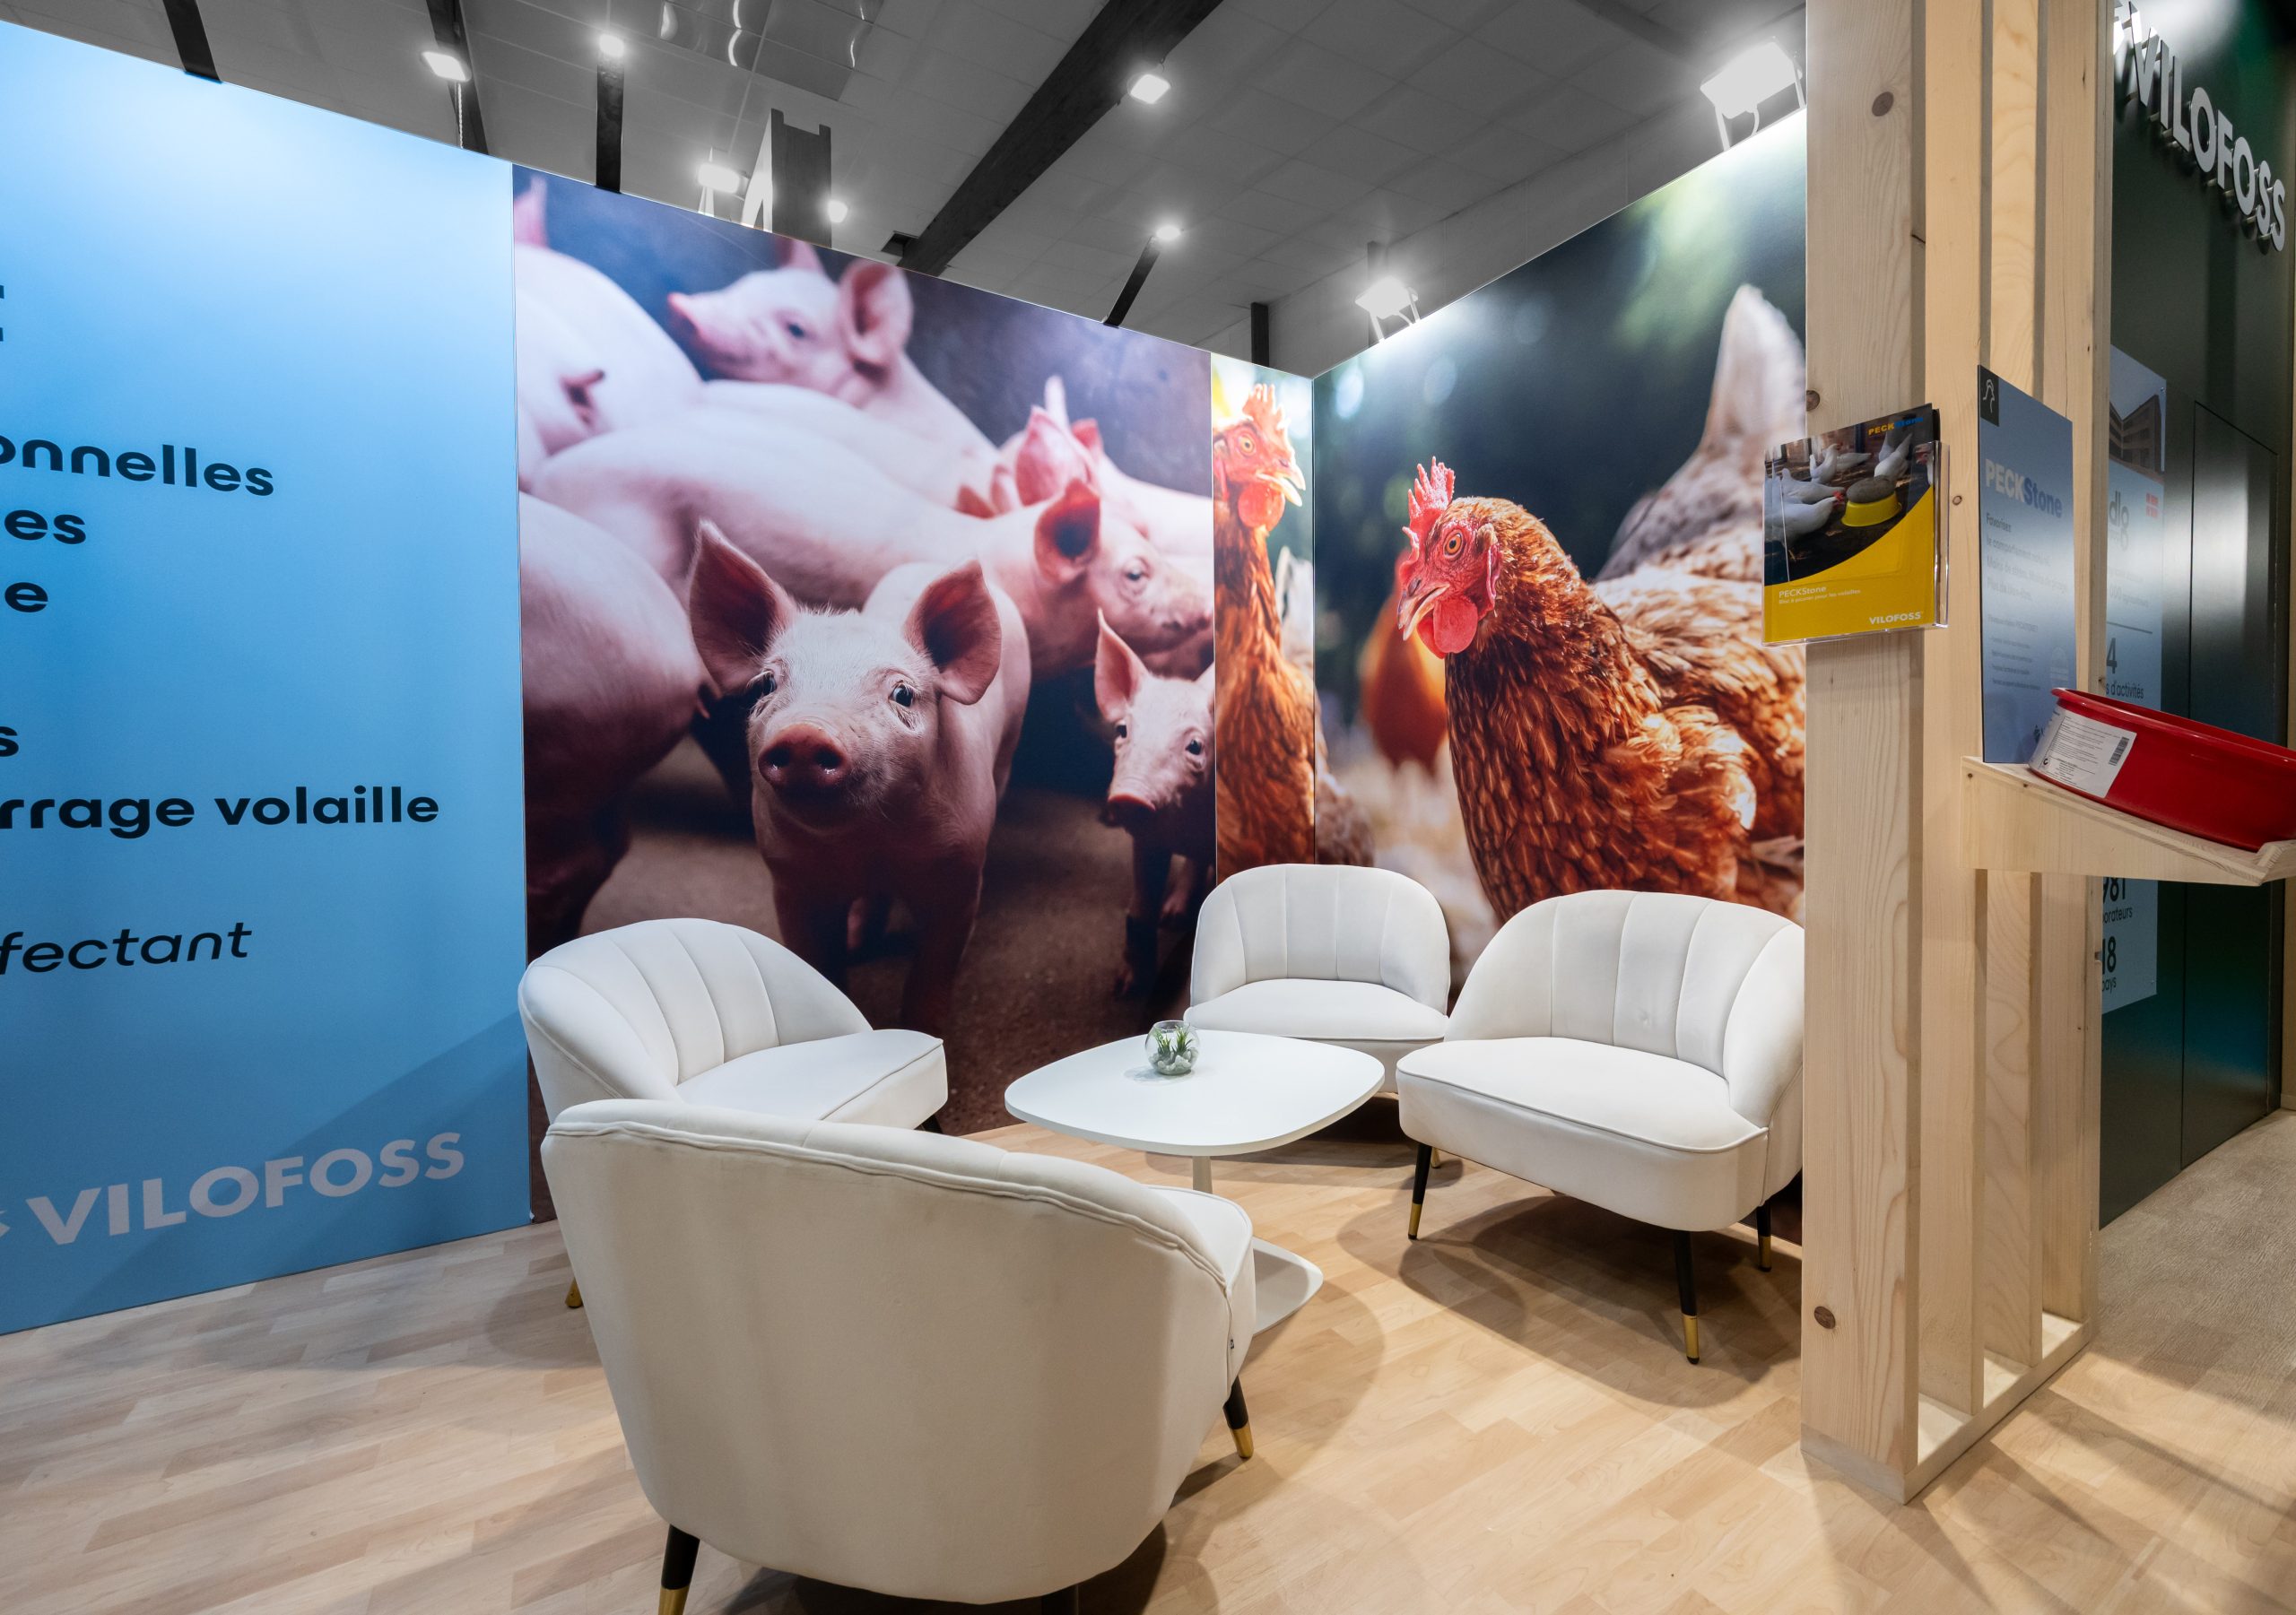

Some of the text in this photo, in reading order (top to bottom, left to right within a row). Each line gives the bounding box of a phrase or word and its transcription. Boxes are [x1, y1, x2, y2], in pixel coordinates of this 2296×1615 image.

[2128, 1, 2285, 252] VILOFOSS
[1985, 458, 2063, 518] PECKStone
[4, 509, 87, 544] es
[1779, 586, 1827, 599] PECKStone
[1869, 612, 1922, 624] VILOFOSS
[2110, 681, 2144, 699] d'activités
[0, 785, 439, 839] rrage volaille
[0, 922, 252, 975] fectant
[2101, 977, 2117, 994] ays
[25, 1132, 465, 1246] VILOFOSS
